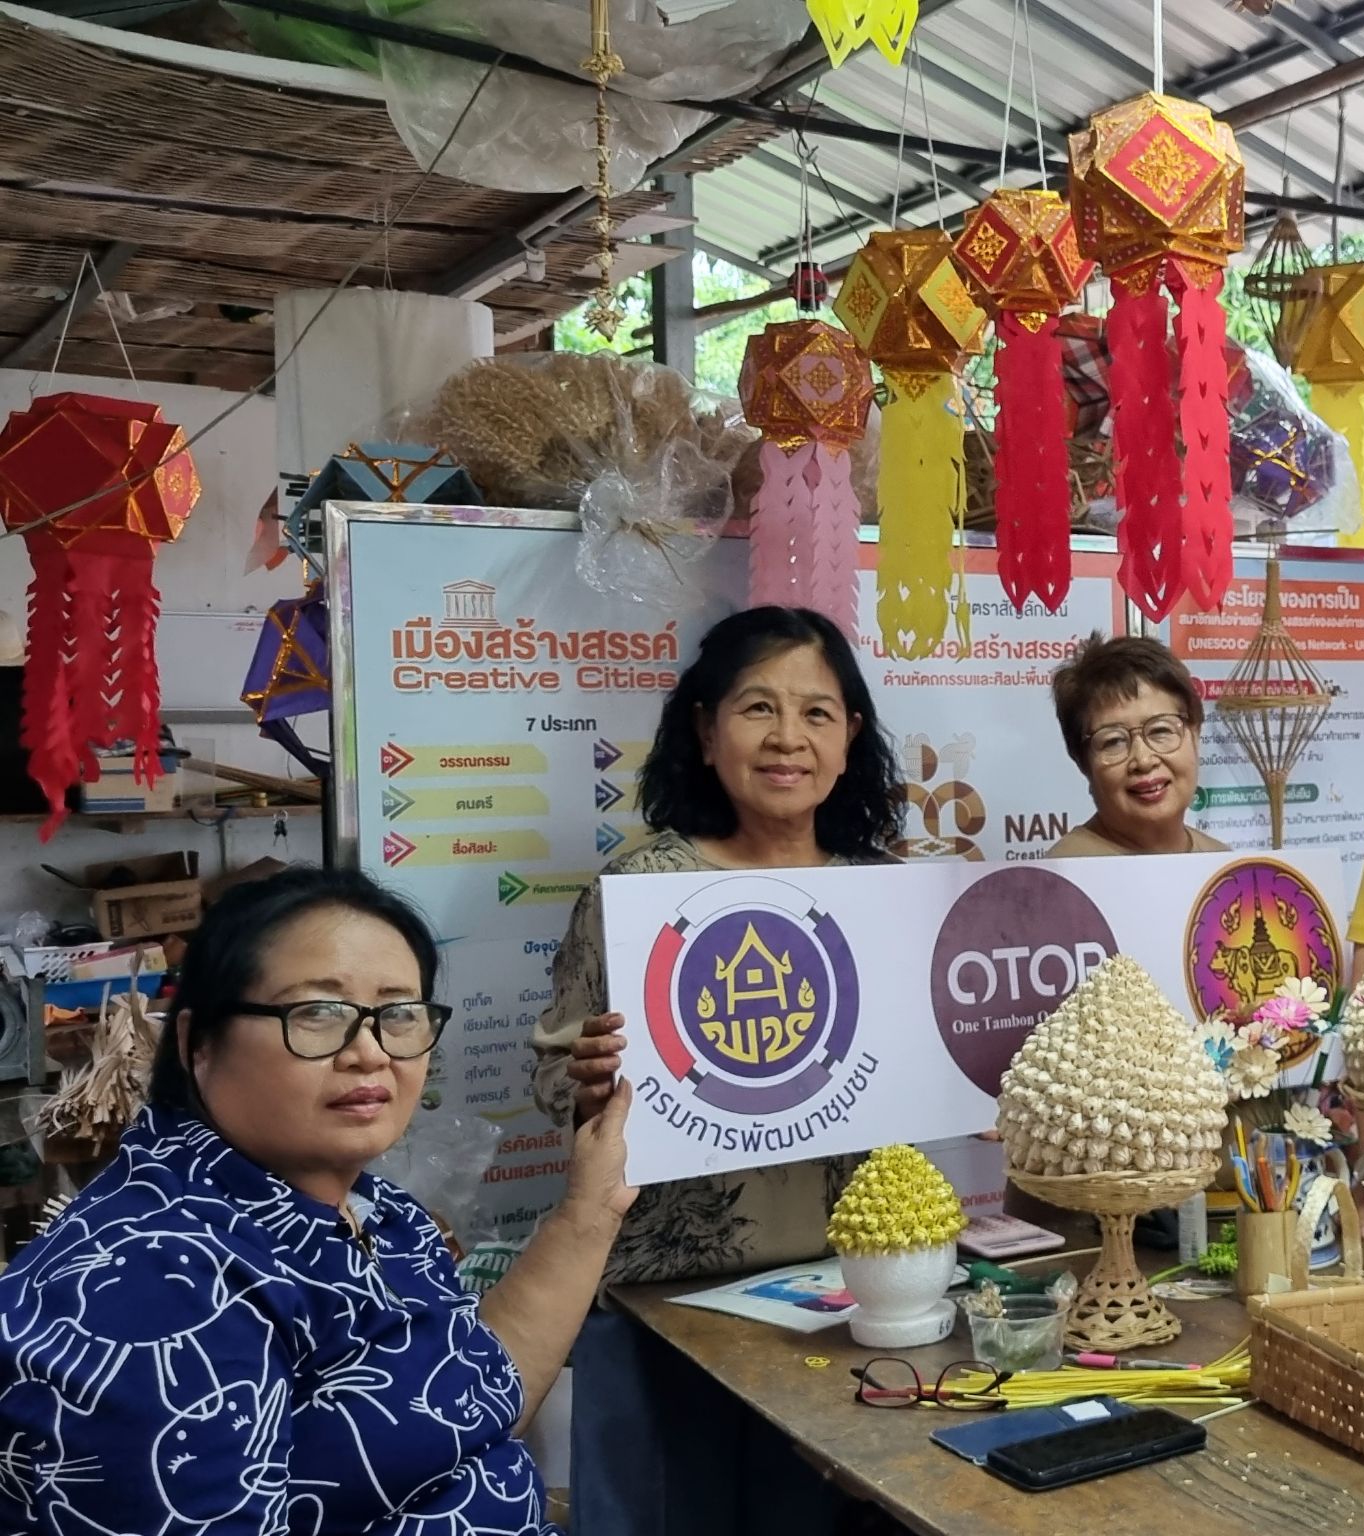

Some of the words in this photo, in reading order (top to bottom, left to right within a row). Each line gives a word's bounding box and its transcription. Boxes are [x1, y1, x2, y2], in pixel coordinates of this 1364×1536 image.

[392, 616, 678, 661] เมืองสร้างสรรค์
[393, 666, 560, 690] Creative
[576, 666, 677, 690] Cities
[526, 718, 536, 732] 7
[541, 714, 597, 733] ประเภท
[439, 756, 510, 769] วรรณกรรม
[456, 795, 493, 811] ดนตรี
[1004, 813, 1068, 843] NAN
[1005, 848, 1047, 861] Creati
[947, 942, 1108, 1005] OTOP
[952, 1019, 980, 1035] One
[983, 1013, 1034, 1031] Tambon
[637, 1052, 880, 1152] กรมการพัฒนาชุมชน
